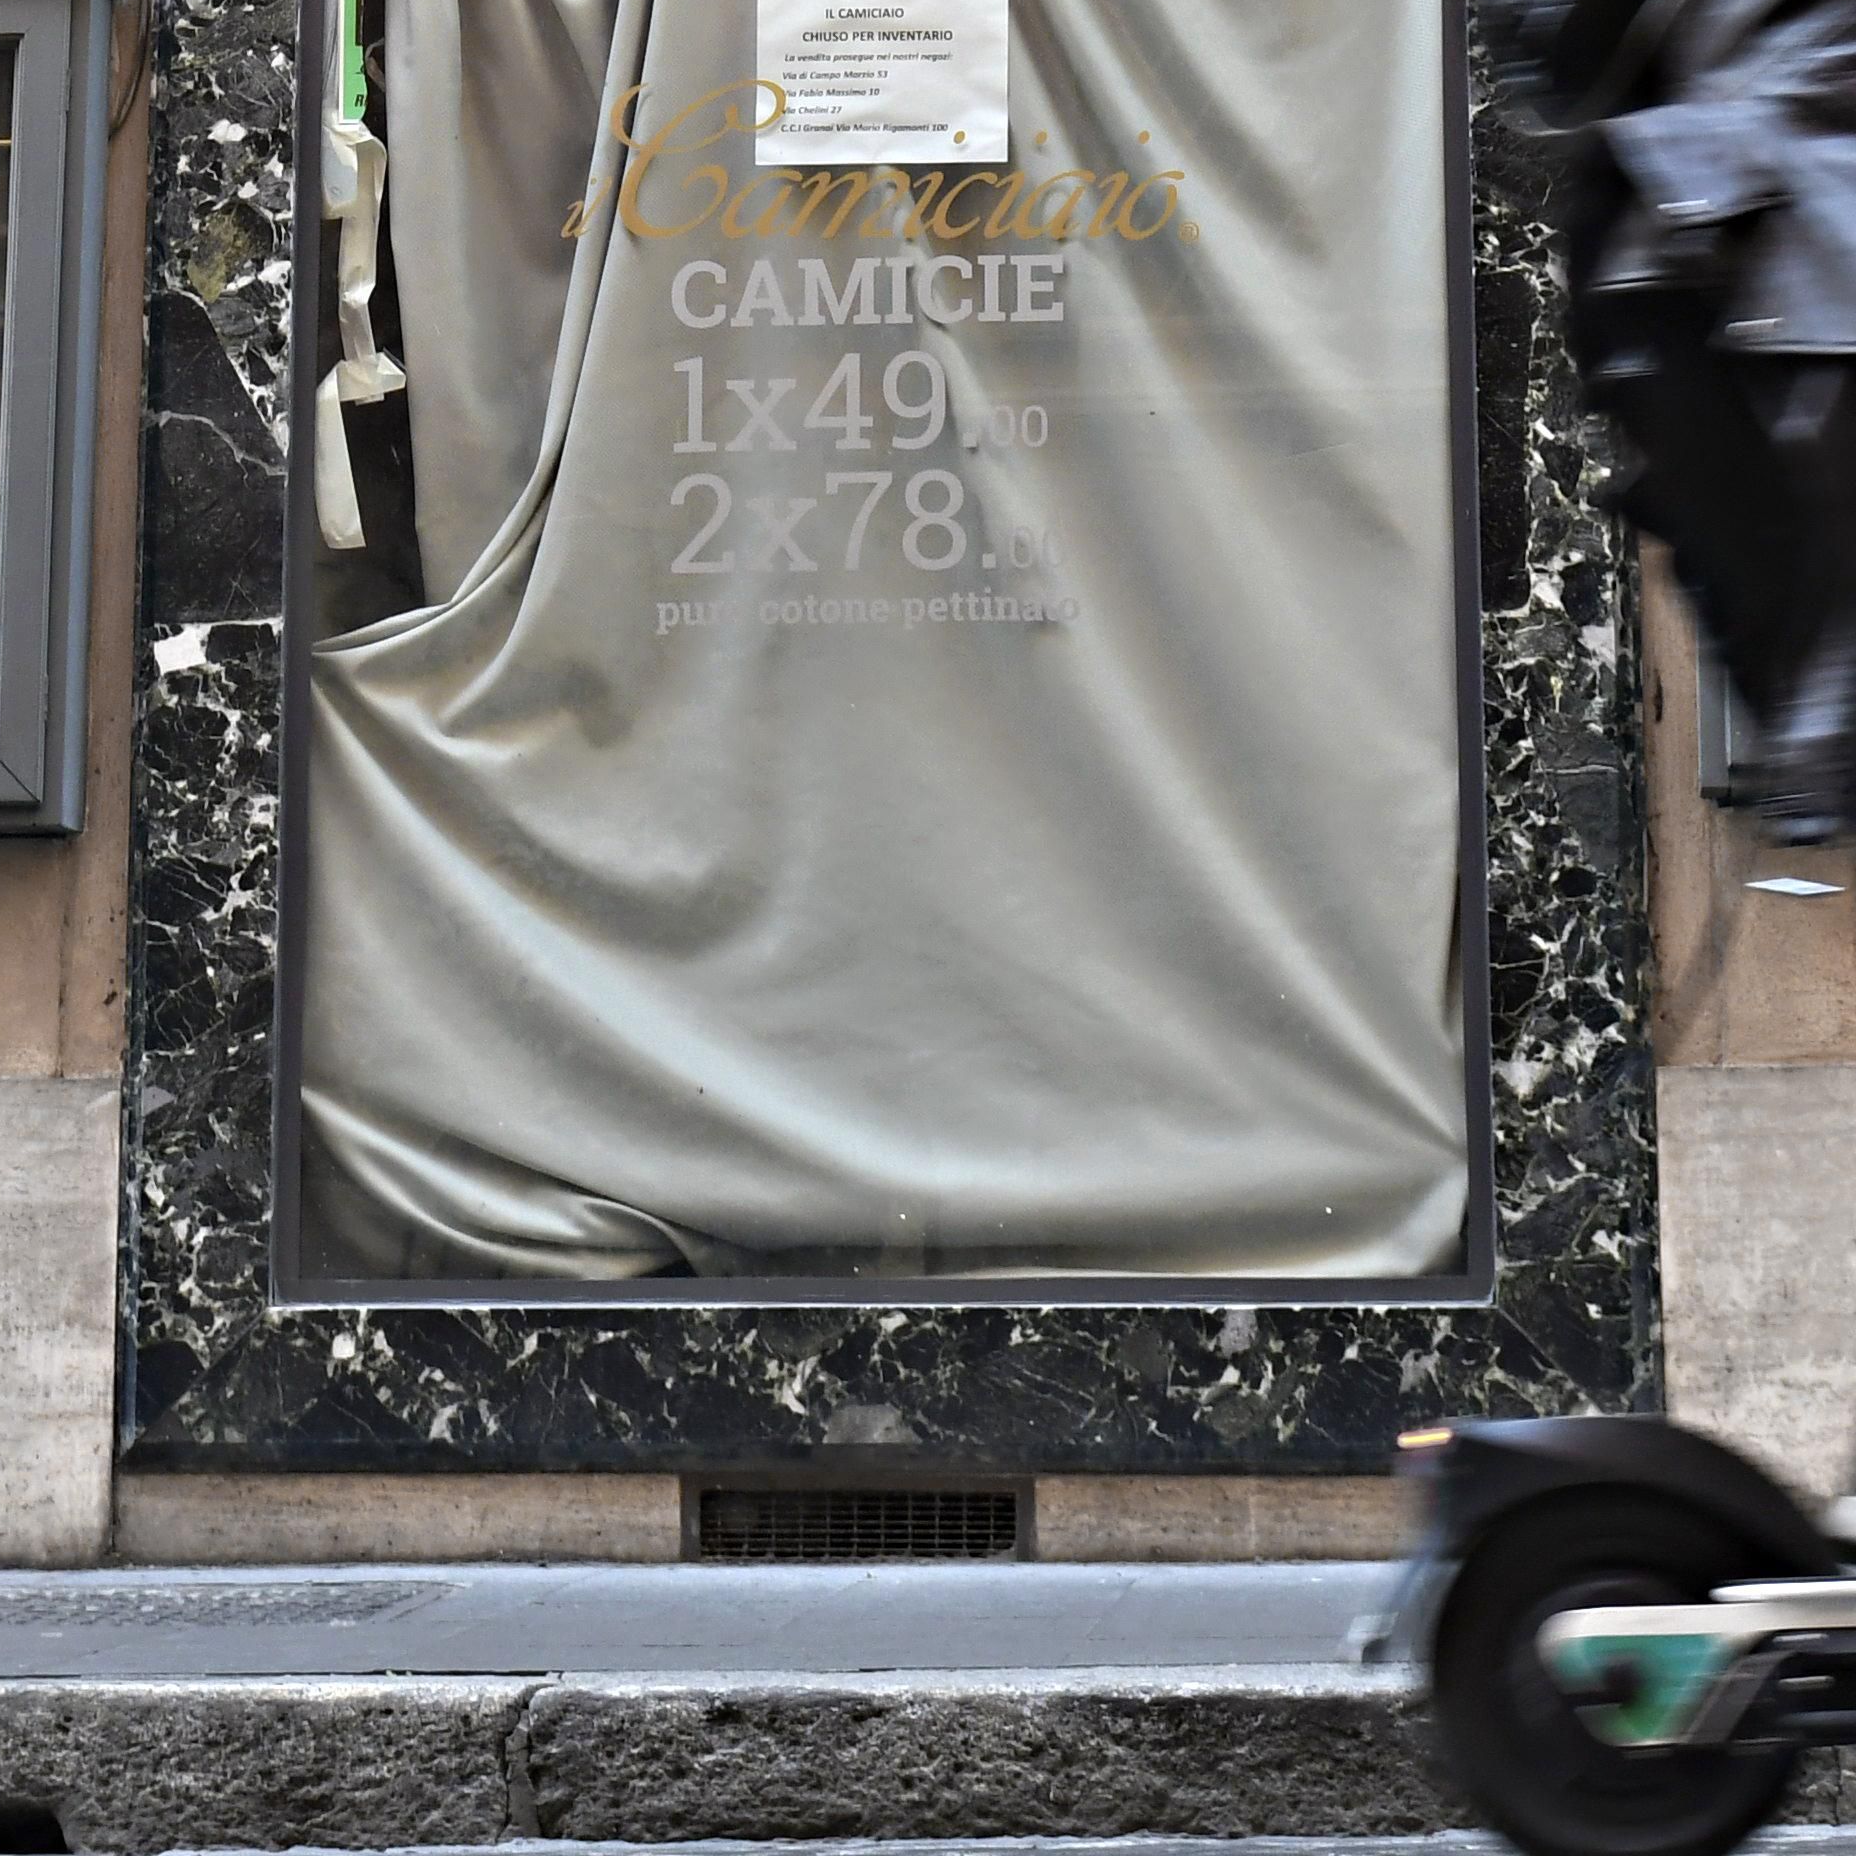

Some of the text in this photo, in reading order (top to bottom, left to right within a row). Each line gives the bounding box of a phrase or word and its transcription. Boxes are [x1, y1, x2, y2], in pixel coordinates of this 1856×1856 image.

[825, 8, 904, 19] IL CAMICIAIO
[802, 30, 953, 42] CHIUSO PER INVENTARIO
[785, 54, 795, 62] La
[797, 53, 831, 61] vendita
[833, 54, 874, 63] prosegue
[893, 52, 919, 60] nostri
[782, 71, 797, 80] Via
[799, 71, 808, 80] di
[810, 71, 841, 80] Campo
[843, 70, 874, 79] Marzio
[799, 89, 824, 97] Fabio
[826, 88, 866, 96] Massimo
[869, 88, 880, 96] 10
[836, 124, 851, 132] Via
[852, 123, 880, 132] Mario
[883, 123, 929, 133] Rigamonti
[671, 254, 1064, 329] CAMICIE
[655, 599, 741, 635] pur
[759, 593, 892, 625] cotone
